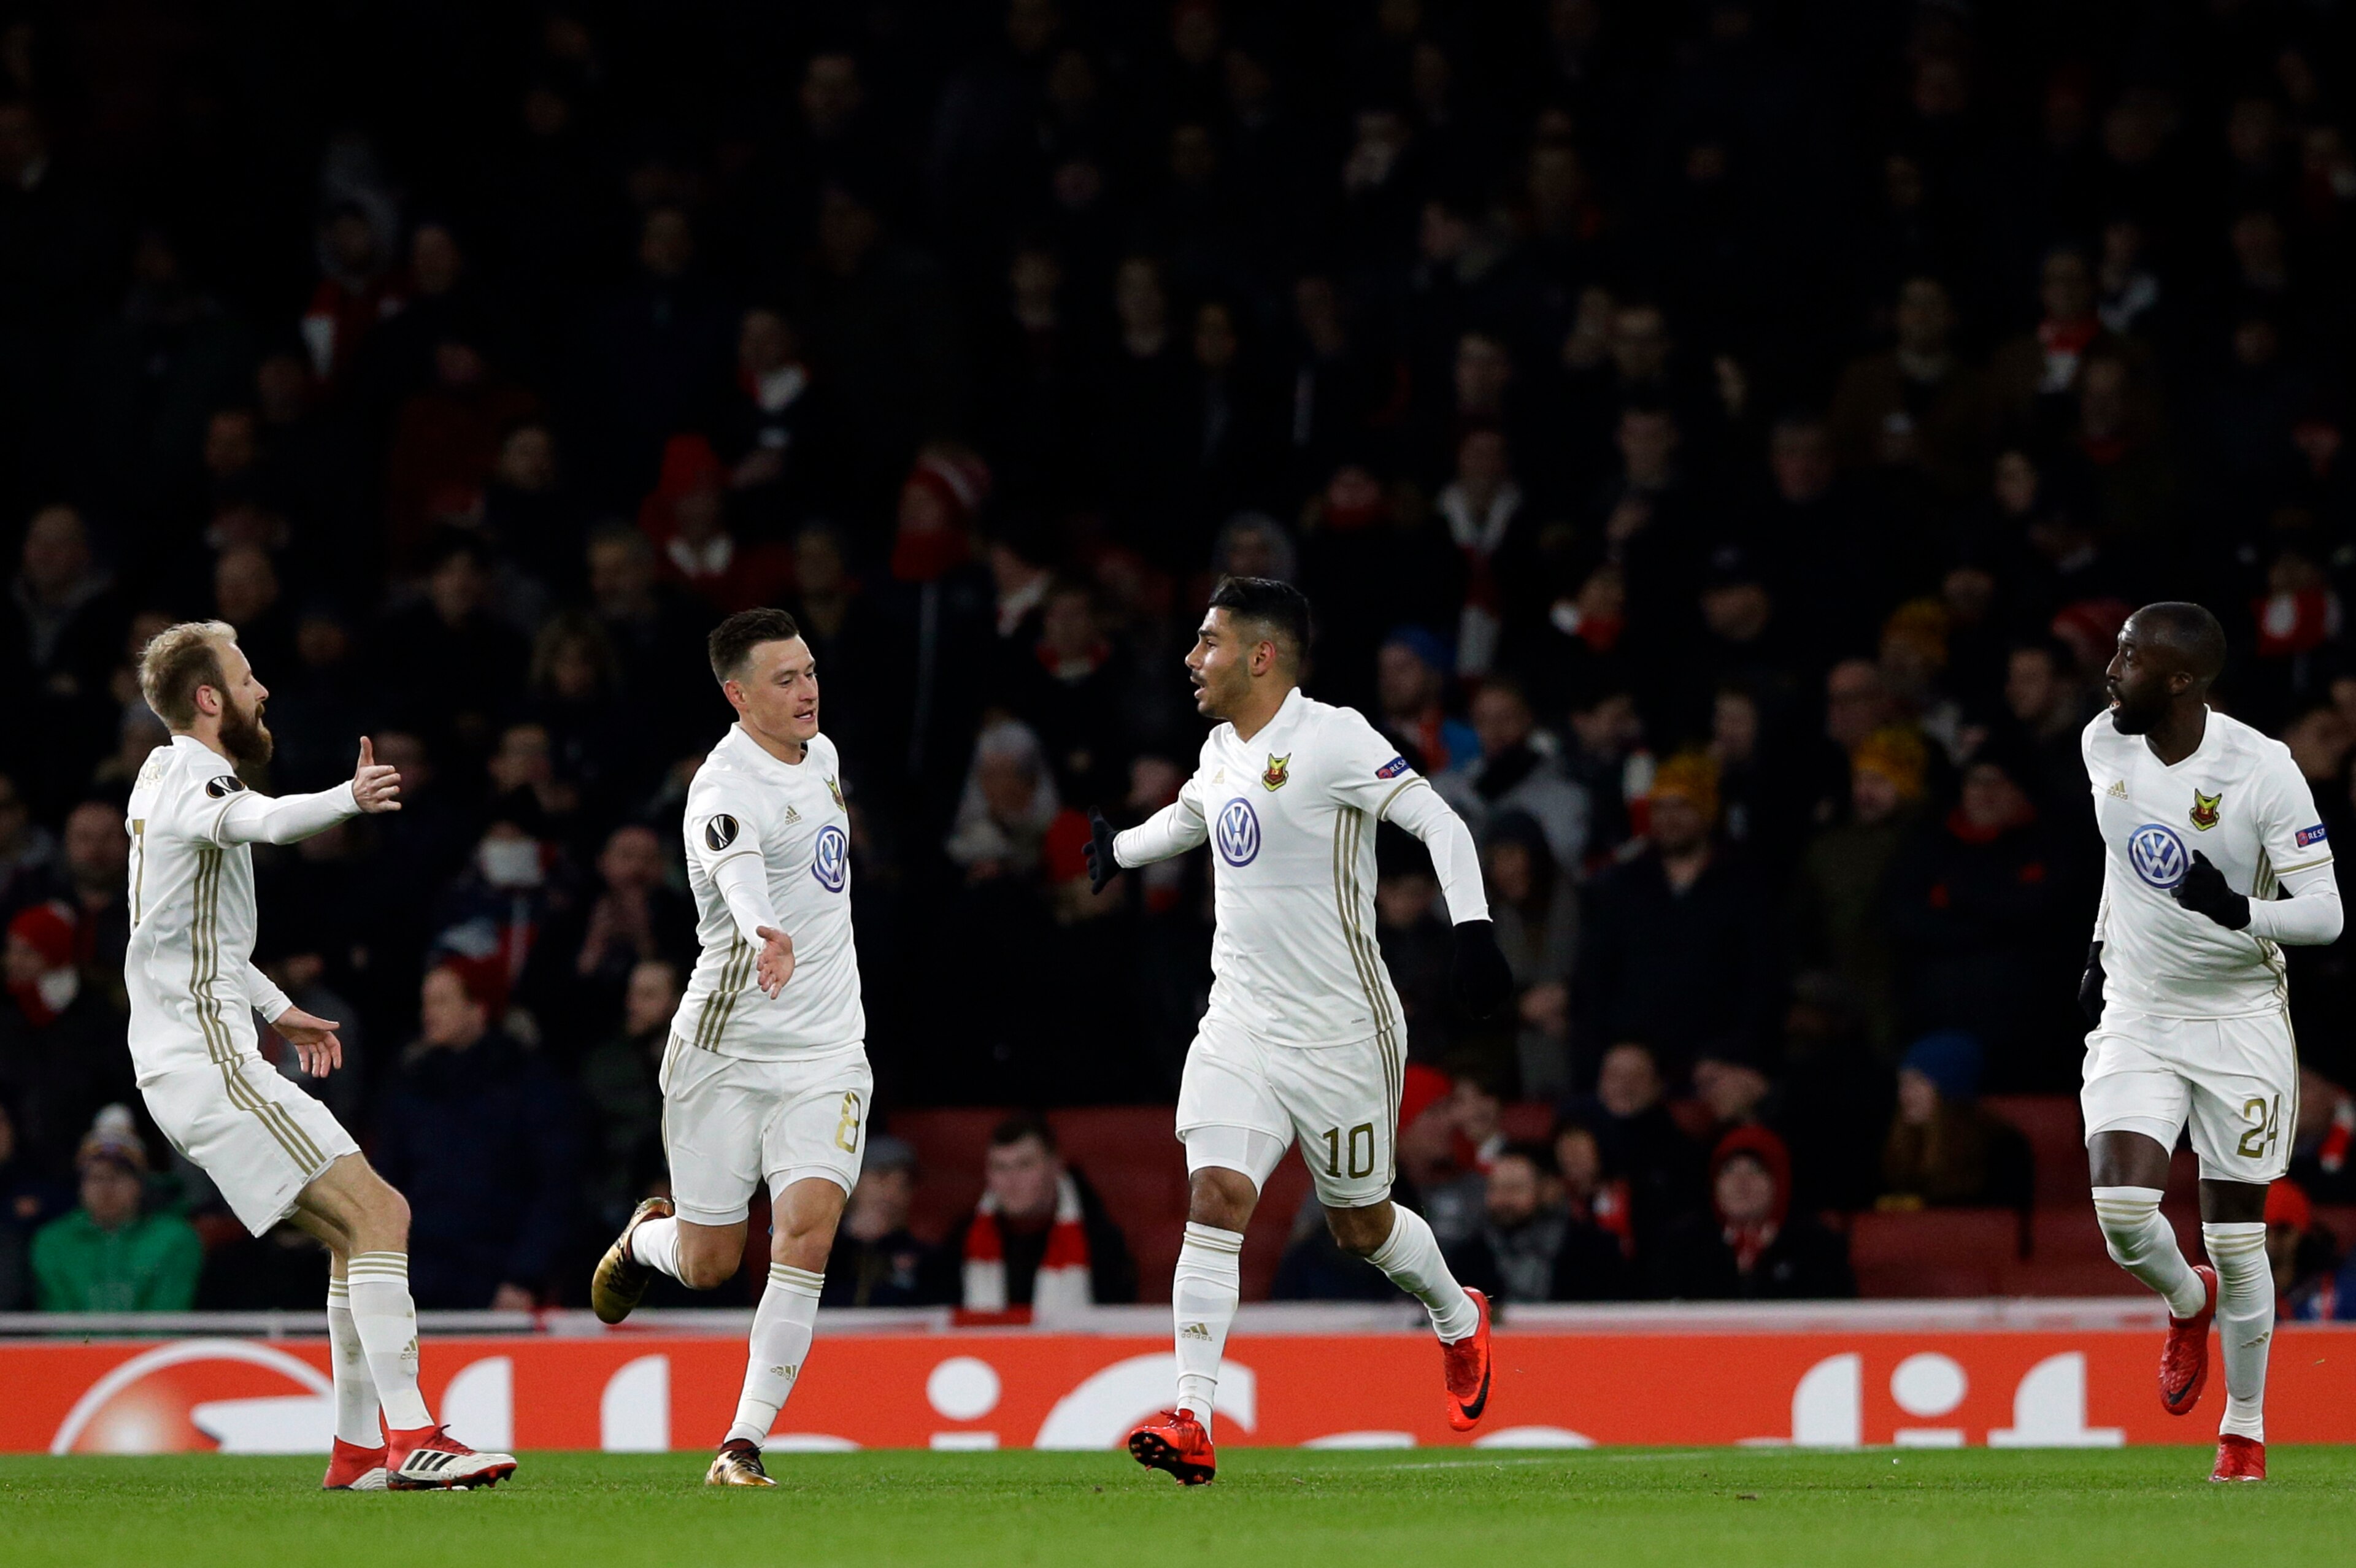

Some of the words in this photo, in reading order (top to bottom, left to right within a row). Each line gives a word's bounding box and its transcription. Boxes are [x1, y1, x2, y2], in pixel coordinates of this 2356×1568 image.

[835, 1091, 861, 1154] 8
[1323, 1122, 1374, 1179] 10
[2236, 1094, 2280, 1159] 24
